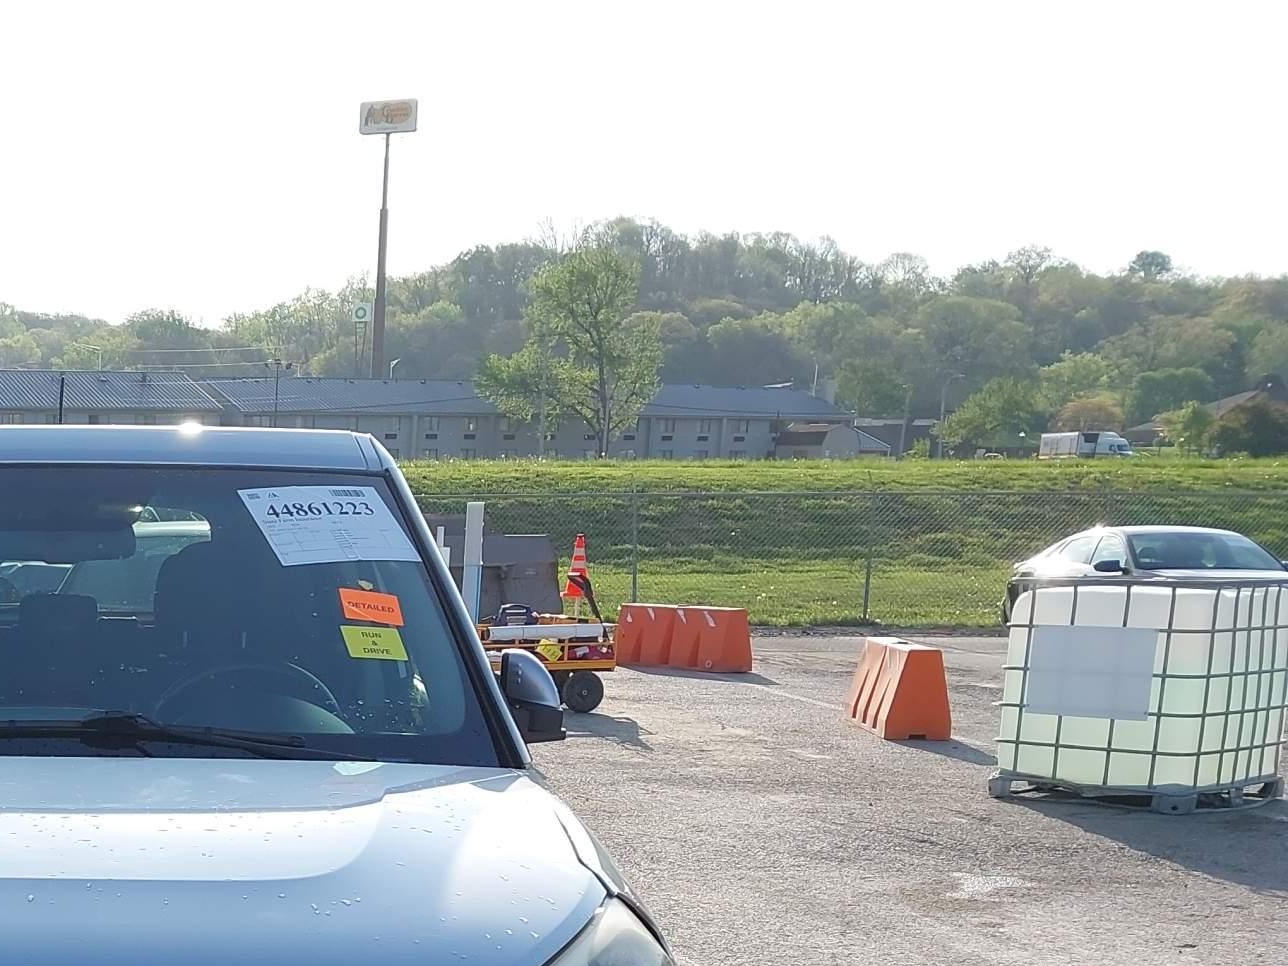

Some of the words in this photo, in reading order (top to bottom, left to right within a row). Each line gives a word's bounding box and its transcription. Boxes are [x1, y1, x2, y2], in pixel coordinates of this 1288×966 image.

[266, 501, 375, 519] 44861223
[347, 601, 395, 613] DETAILED
[361, 631, 382, 639] RUN
[363, 647, 391, 655] DRIVE
